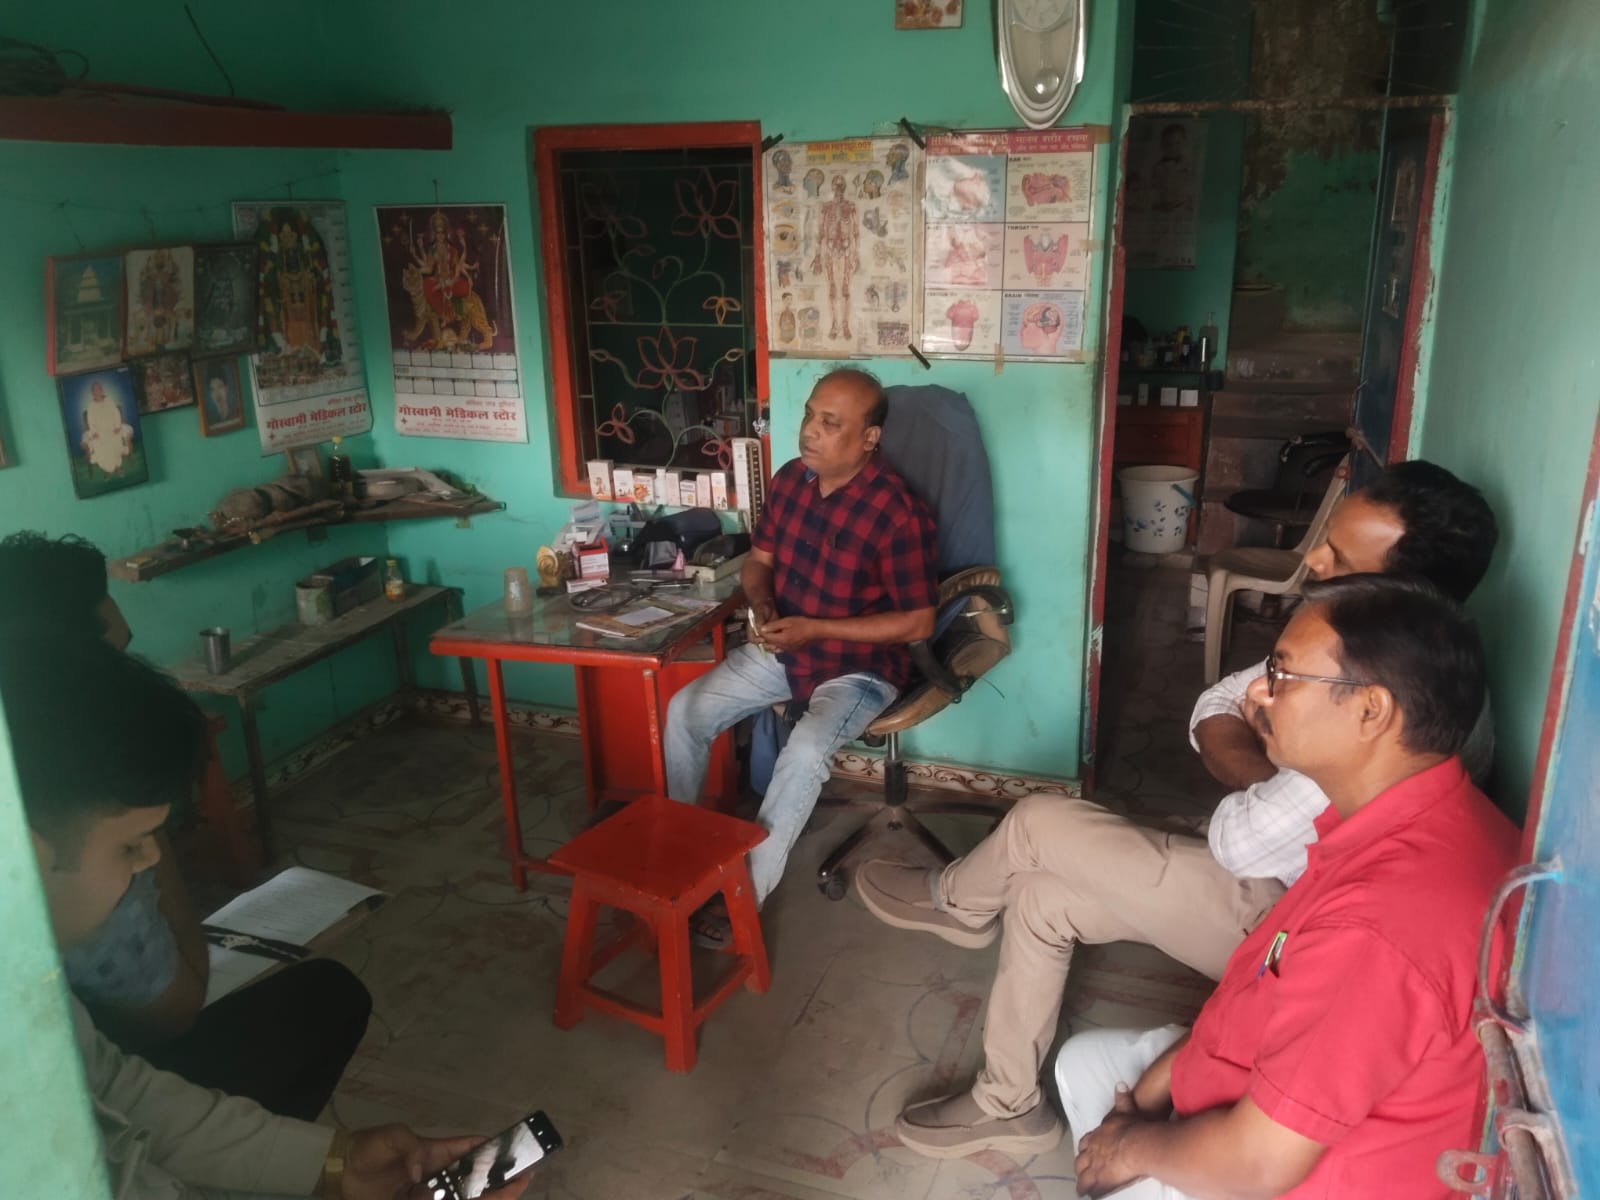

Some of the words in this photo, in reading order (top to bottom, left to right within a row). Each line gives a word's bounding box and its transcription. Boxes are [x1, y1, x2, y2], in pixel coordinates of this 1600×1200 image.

[266, 412, 307, 429] गोस्वामी
[310, 407, 346, 422] मेडिकल
[349, 402, 367, 415] स्टोर
[398, 404, 442, 417] गोस्वामी
[445, 406, 489, 420] मेडिकल
[493, 409, 517, 420] स्टोर
